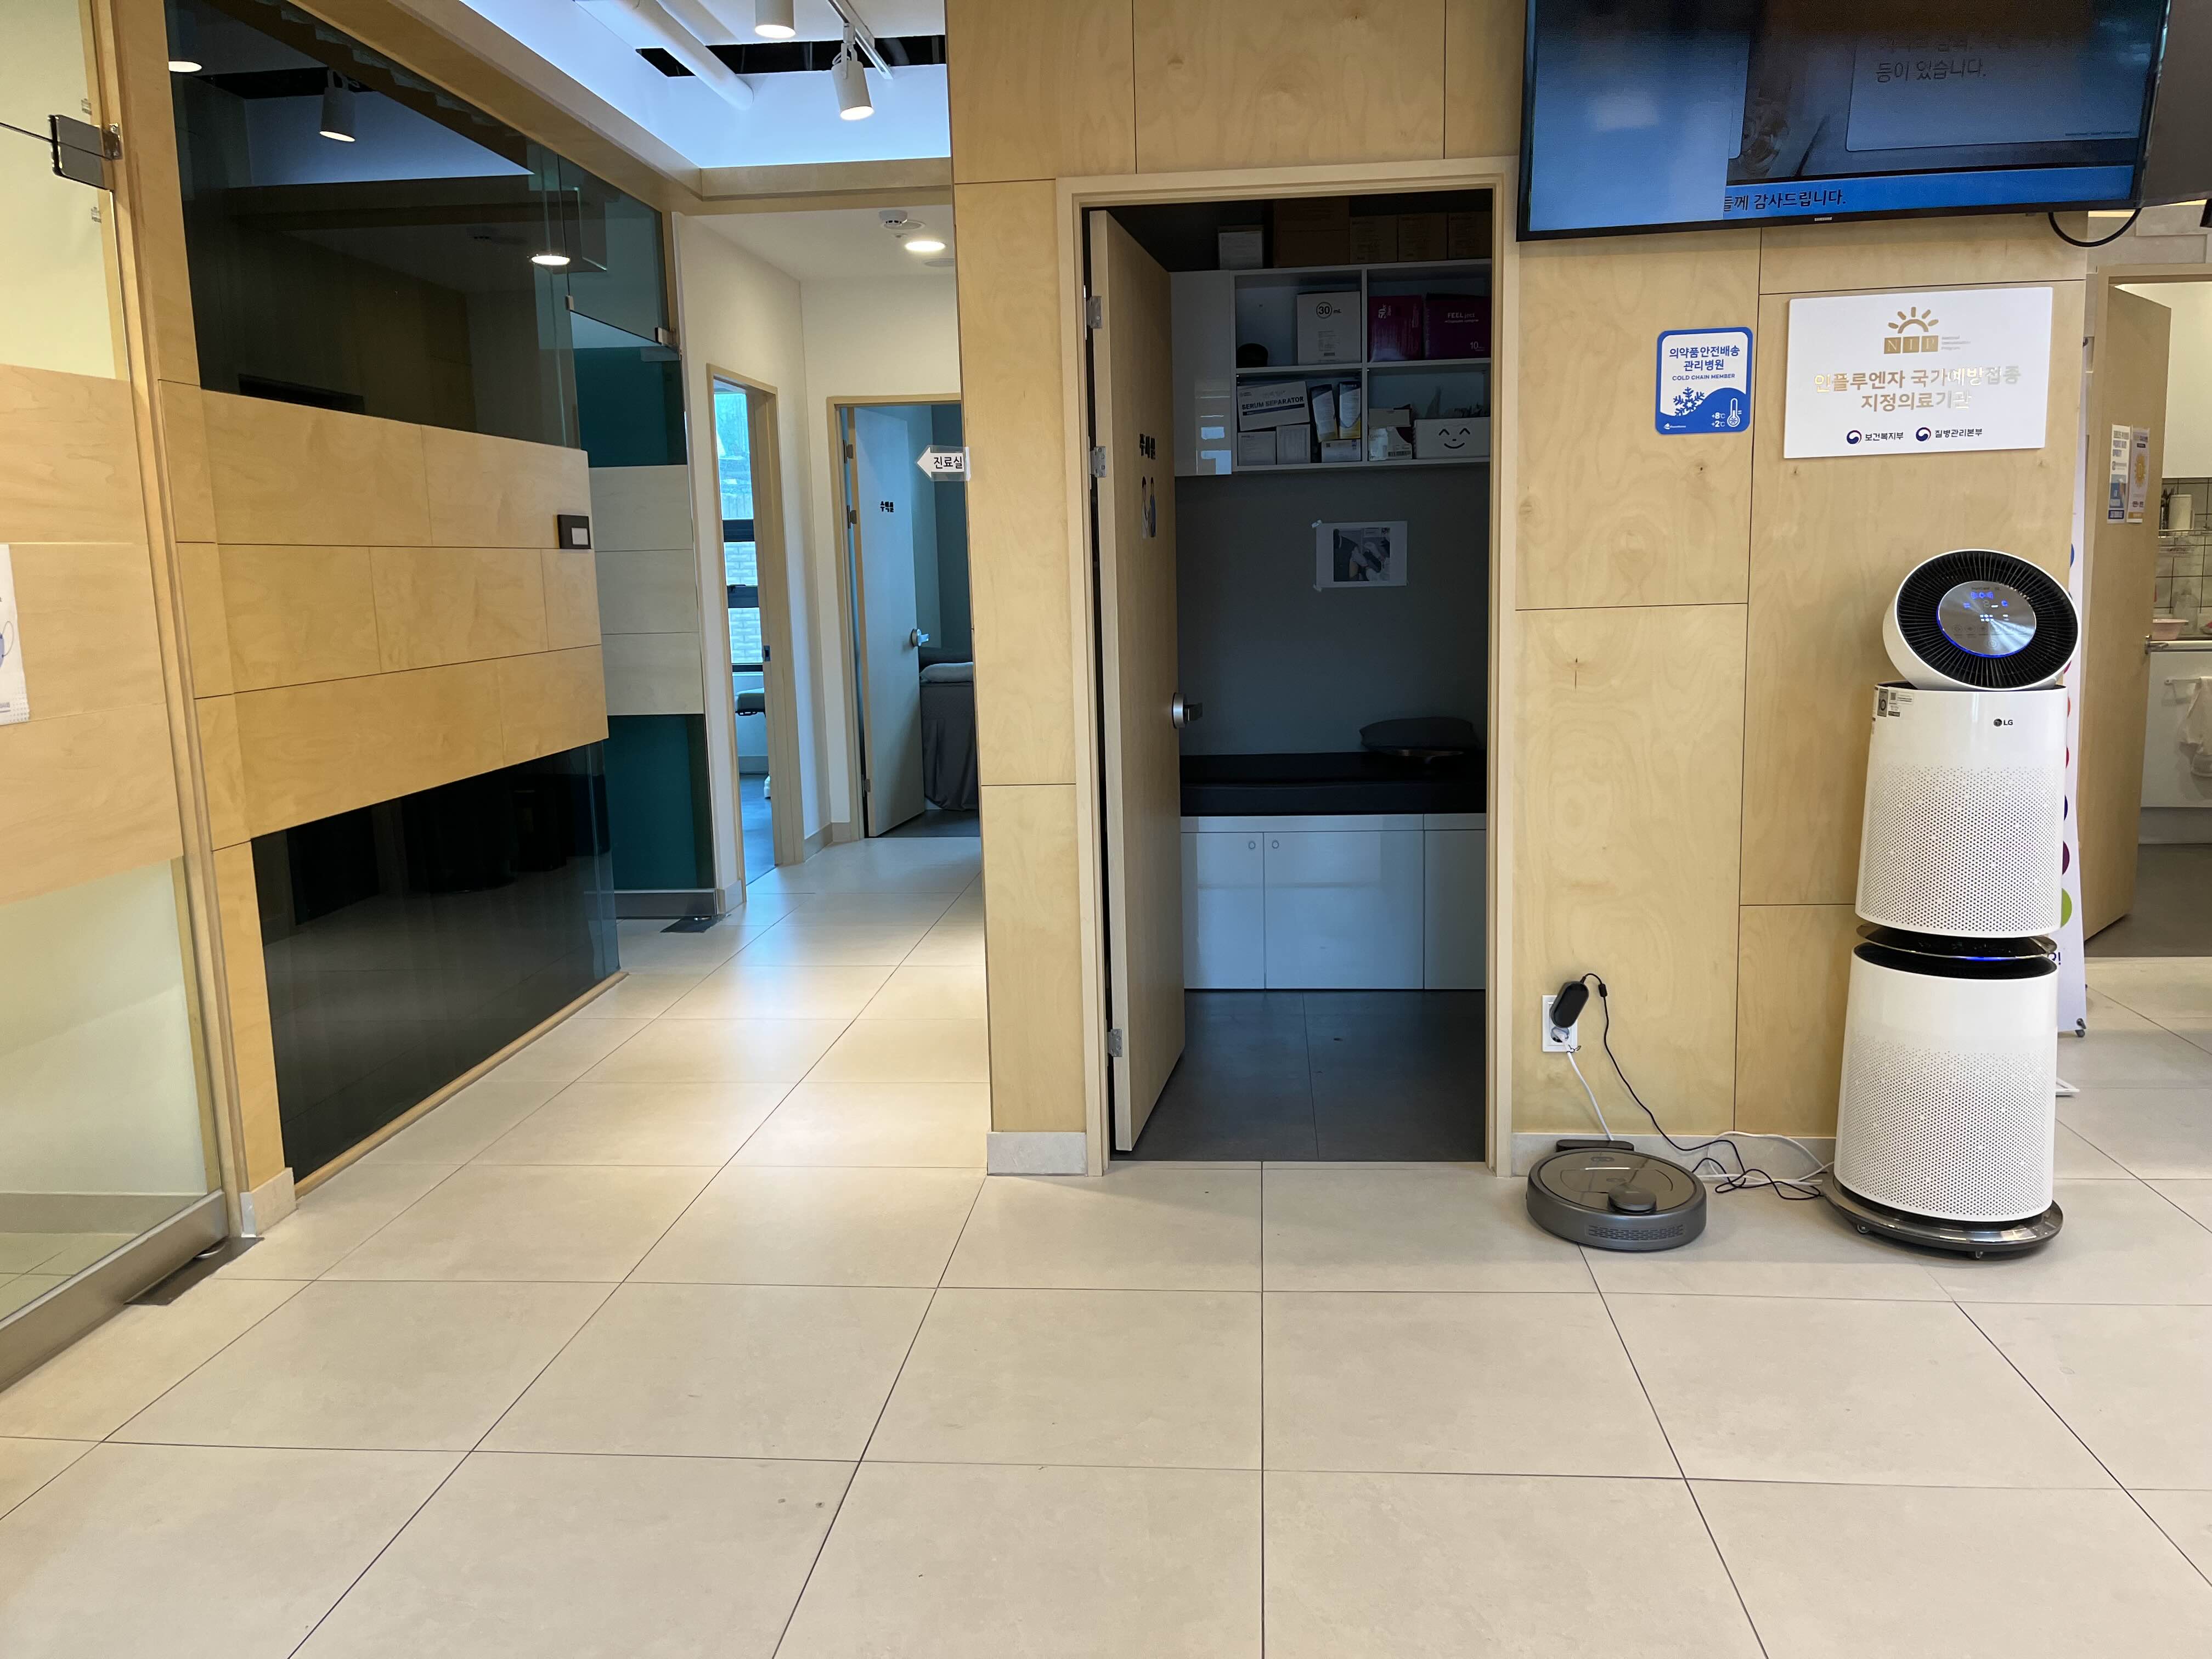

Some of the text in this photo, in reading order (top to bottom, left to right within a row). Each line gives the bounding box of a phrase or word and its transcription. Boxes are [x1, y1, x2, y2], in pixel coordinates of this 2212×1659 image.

[1876, 58, 1987, 83] 등이 있습니다.
[1753, 189, 1846, 210] 감사드립니다.
[1318, 306, 1330, 314] 30
[1886, 337, 1936, 353] NIP
[1814, 370, 1905, 393] 인플루엔자
[1242, 396, 1304, 410] SERUM SEPARATOR
[1861, 390, 1972, 412] 지정의료기관
[1865, 432, 1904, 441] 보건복지부
[1935, 428, 1983, 438] 질병관리본부
[933, 456, 963, 469] 진료실
